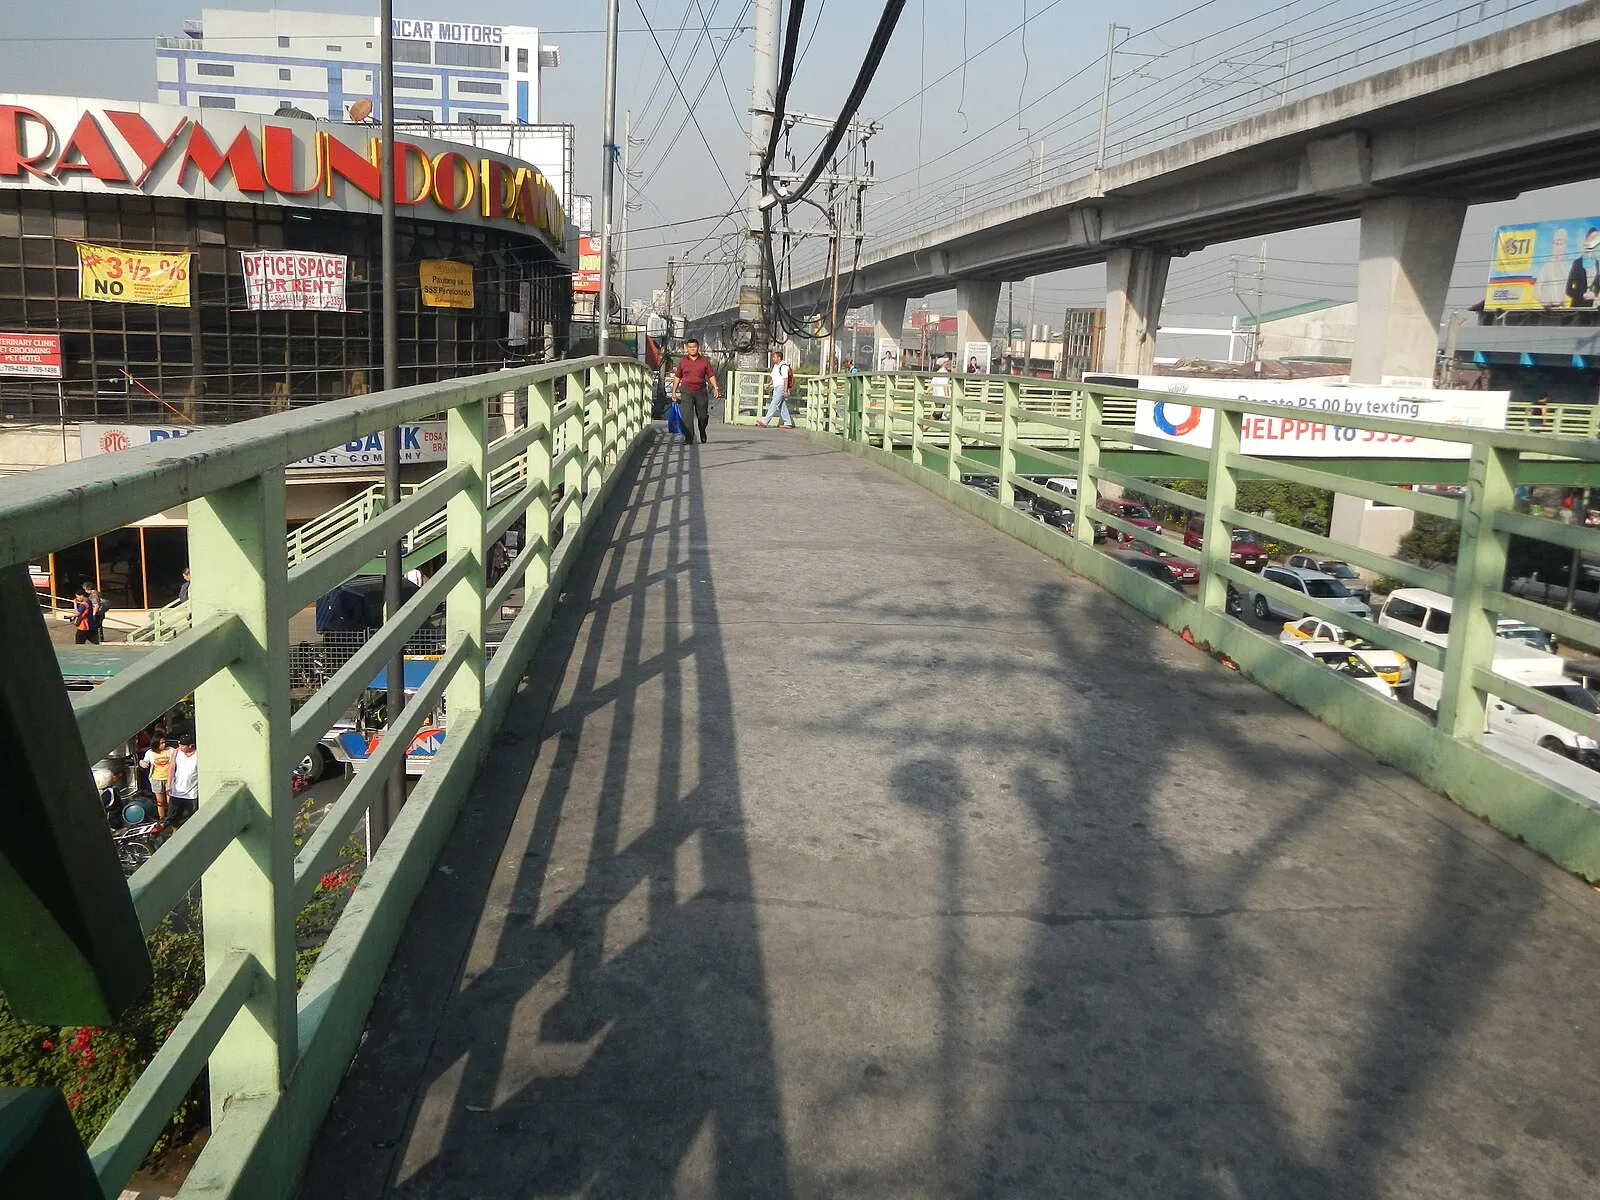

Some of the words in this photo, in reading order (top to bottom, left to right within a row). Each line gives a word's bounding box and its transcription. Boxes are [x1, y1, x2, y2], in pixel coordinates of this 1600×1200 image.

[439, 23, 503, 44] MOTORS
[0, 104, 475, 212] RAYMUNDO
[1510, 239, 1531, 255] STI
[244, 256, 294, 277] OFFICE
[298, 257, 343, 279] SPACE
[94, 279, 124, 296] NO
[255, 279, 287, 292] FOR
[292, 279, 335, 294] RENT
[424, 286, 437, 294] SSS
[33, 339, 56, 347] CLINIC
[1367, 401, 1419, 418] texting
[424, 432, 443, 441] EDSA
[1241, 418, 1326, 440] HELPPH
[1333, 425, 1356, 441] to
[105, 433, 126, 452] PTC
[345, 427, 421, 453] BAK
[299, 455, 338, 464] UST
[350, 452, 422, 462] COMNY
